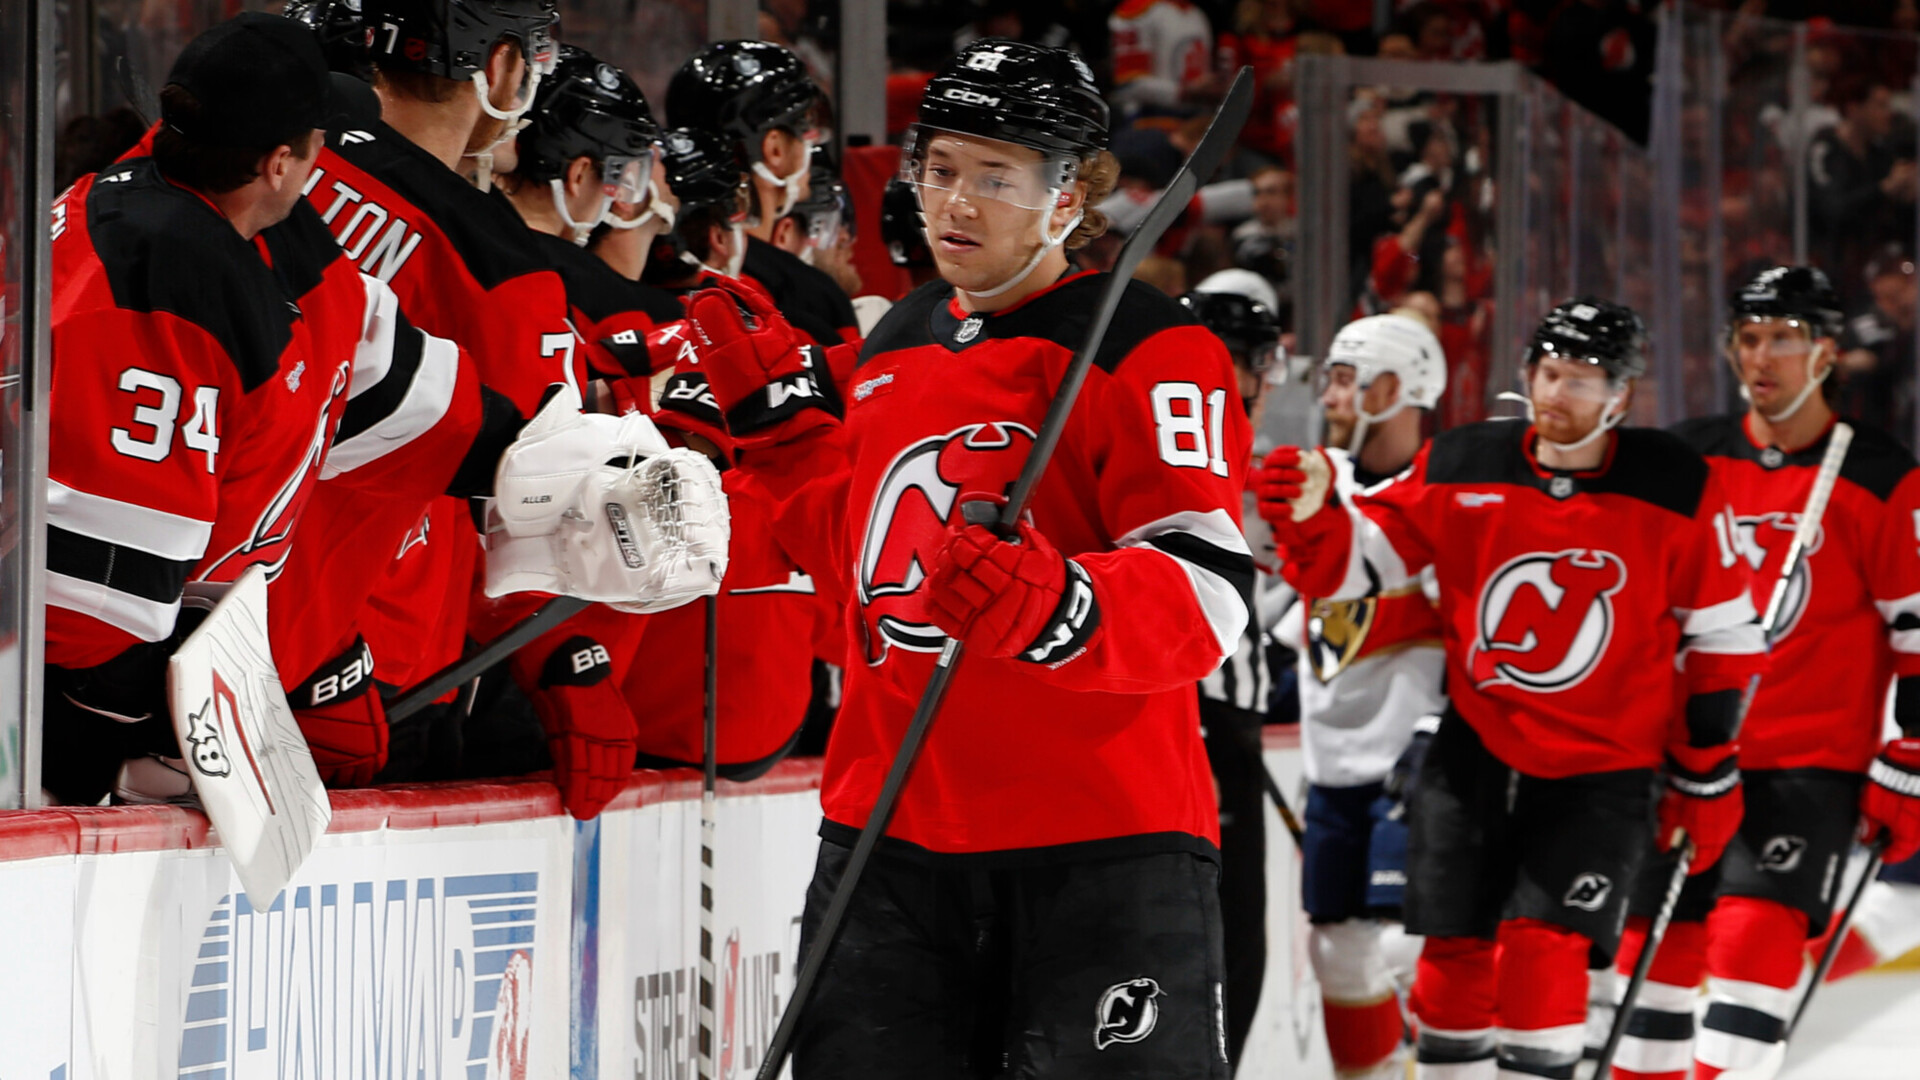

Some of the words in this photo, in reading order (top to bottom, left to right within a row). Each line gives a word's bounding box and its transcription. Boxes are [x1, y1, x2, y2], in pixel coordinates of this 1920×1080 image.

[382, 22, 399, 54] 7
[943, 88, 1001, 107] CCM
[540, 331, 583, 410] 7
[110, 366, 220, 474] 34
[1149, 381, 1229, 479] 81
[521, 494, 553, 505] ALLEN
